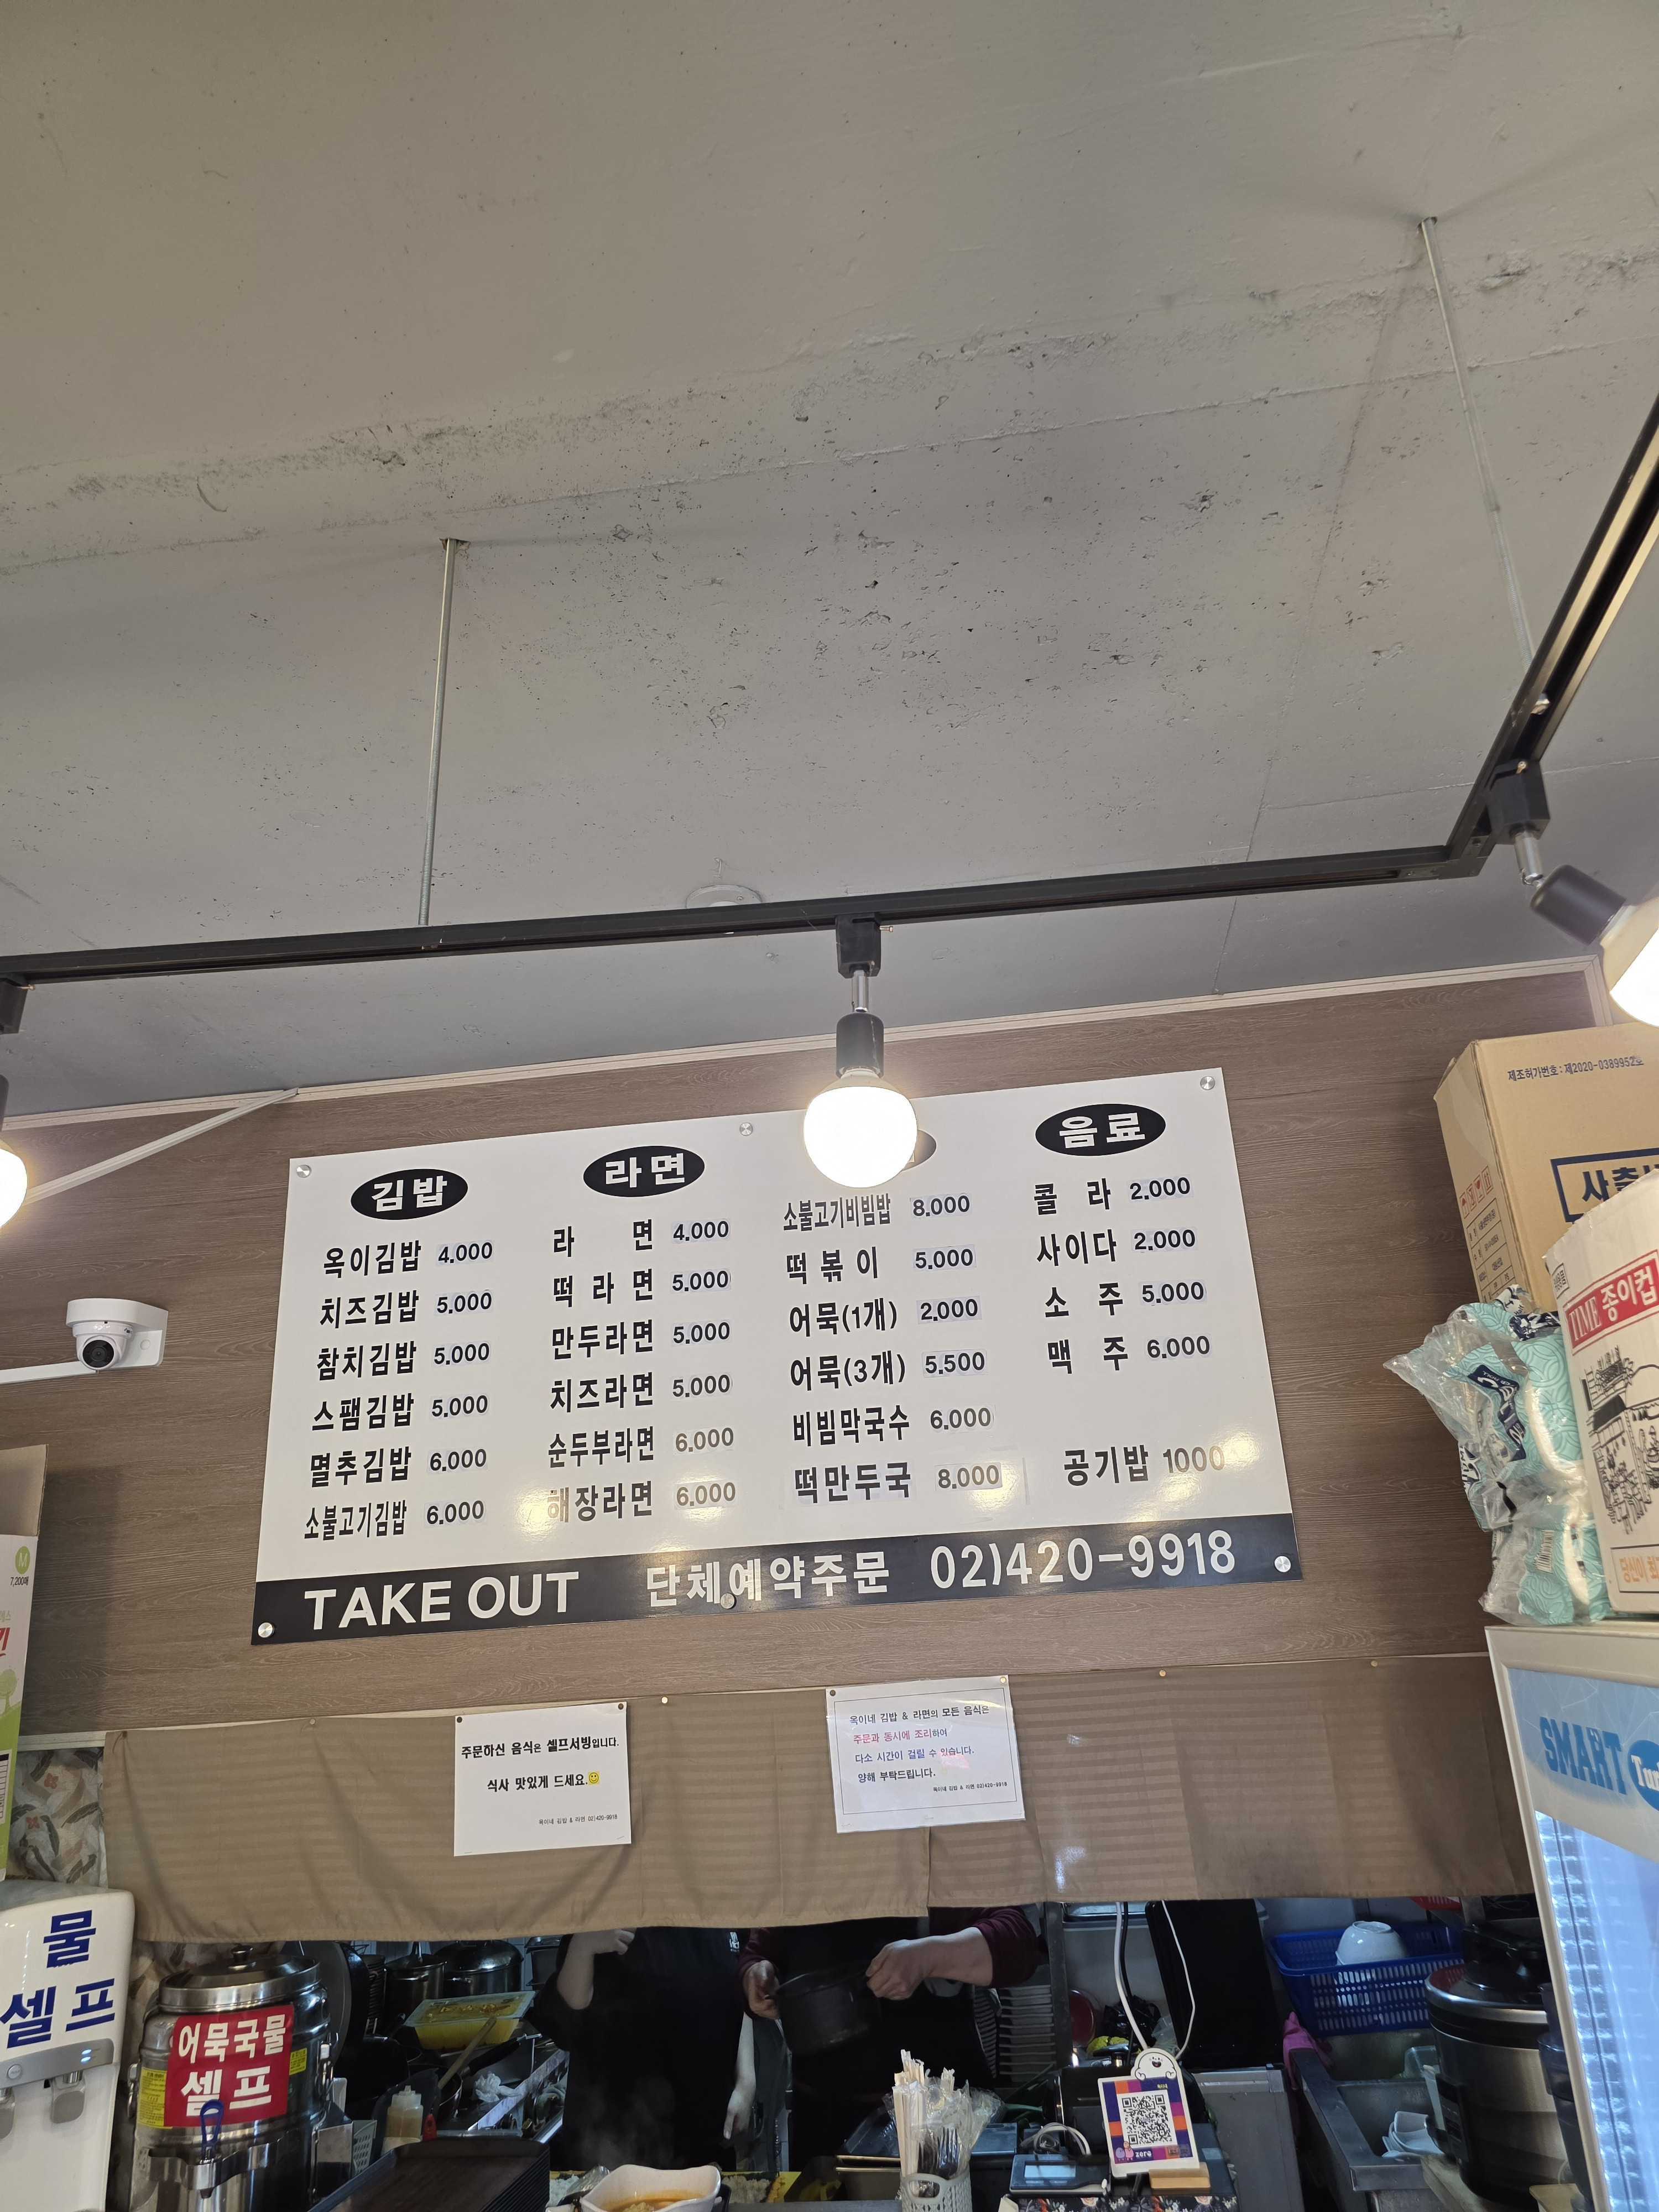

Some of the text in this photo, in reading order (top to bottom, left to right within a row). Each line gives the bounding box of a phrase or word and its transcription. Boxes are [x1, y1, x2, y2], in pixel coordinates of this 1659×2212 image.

[1060, 1113, 1145, 1149] 음료
[606, 1152, 686, 1188] 라면
[372, 1176, 448, 1212] 김밥
[784, 1193, 891, 1232] 소불고기비빔밥
[324, 1240, 421, 1279] 옥이김밥
[1037, 1229, 1117, 1266] 사이다
[320, 1290, 419, 1328] 치즈김밥
[790, 1298, 897, 1337] 어묵(1개)
[1569, 1265, 1657, 1341] TIME 종이컵
[552, 1319, 653, 1360] 만두라면
[317, 1341, 416, 1381] 참치김밥
[791, 1350, 905, 1391] 어묵(3개)
[312, 1393, 414, 1431] 스팸김밥
[550, 1372, 653, 1413] 치즈라면
[793, 1405, 910, 1447] 비빔막국수
[311, 1446, 411, 1488] 멸추김밥
[549, 1426, 654, 1468] 순두부라면
[1064, 1444, 1224, 1486] 공기밥 1000
[547, 1481, 651, 1523] 해장라면
[795, 1462, 910, 1504] 떡만두국
[304, 1500, 406, 1541] 소불고기김밥
[18, 1552, 28, 1567] M
[305, 1580, 451, 1630] TAKE
[468, 1572, 579, 1619] OUT
[931, 1530, 1235, 1589] 02)420-9918
[849, 1704, 990, 1725] 옥이네 김밥 & 라면의 모든 음식은
[461, 1736, 619, 1759] 주문하신 음식은 셀프서빙입니다.
[853, 1728, 948, 1744] 주문과 동시에 조리하여
[855, 1745, 974, 1764] 다소 시간이 걸릴 수 있습니다.
[1539, 1716, 1627, 1796] SMART
[487, 1773, 588, 1792] 식사 맛있게 드세요.
[858, 1768, 936, 1783] 양해 부탁드립니다.
[43, 1910, 96, 1969] 물
[0, 1978, 115, 2049] 셀프
[179, 2014, 286, 2064] 어묵국물
[181, 2066, 272, 2117] 셀프
